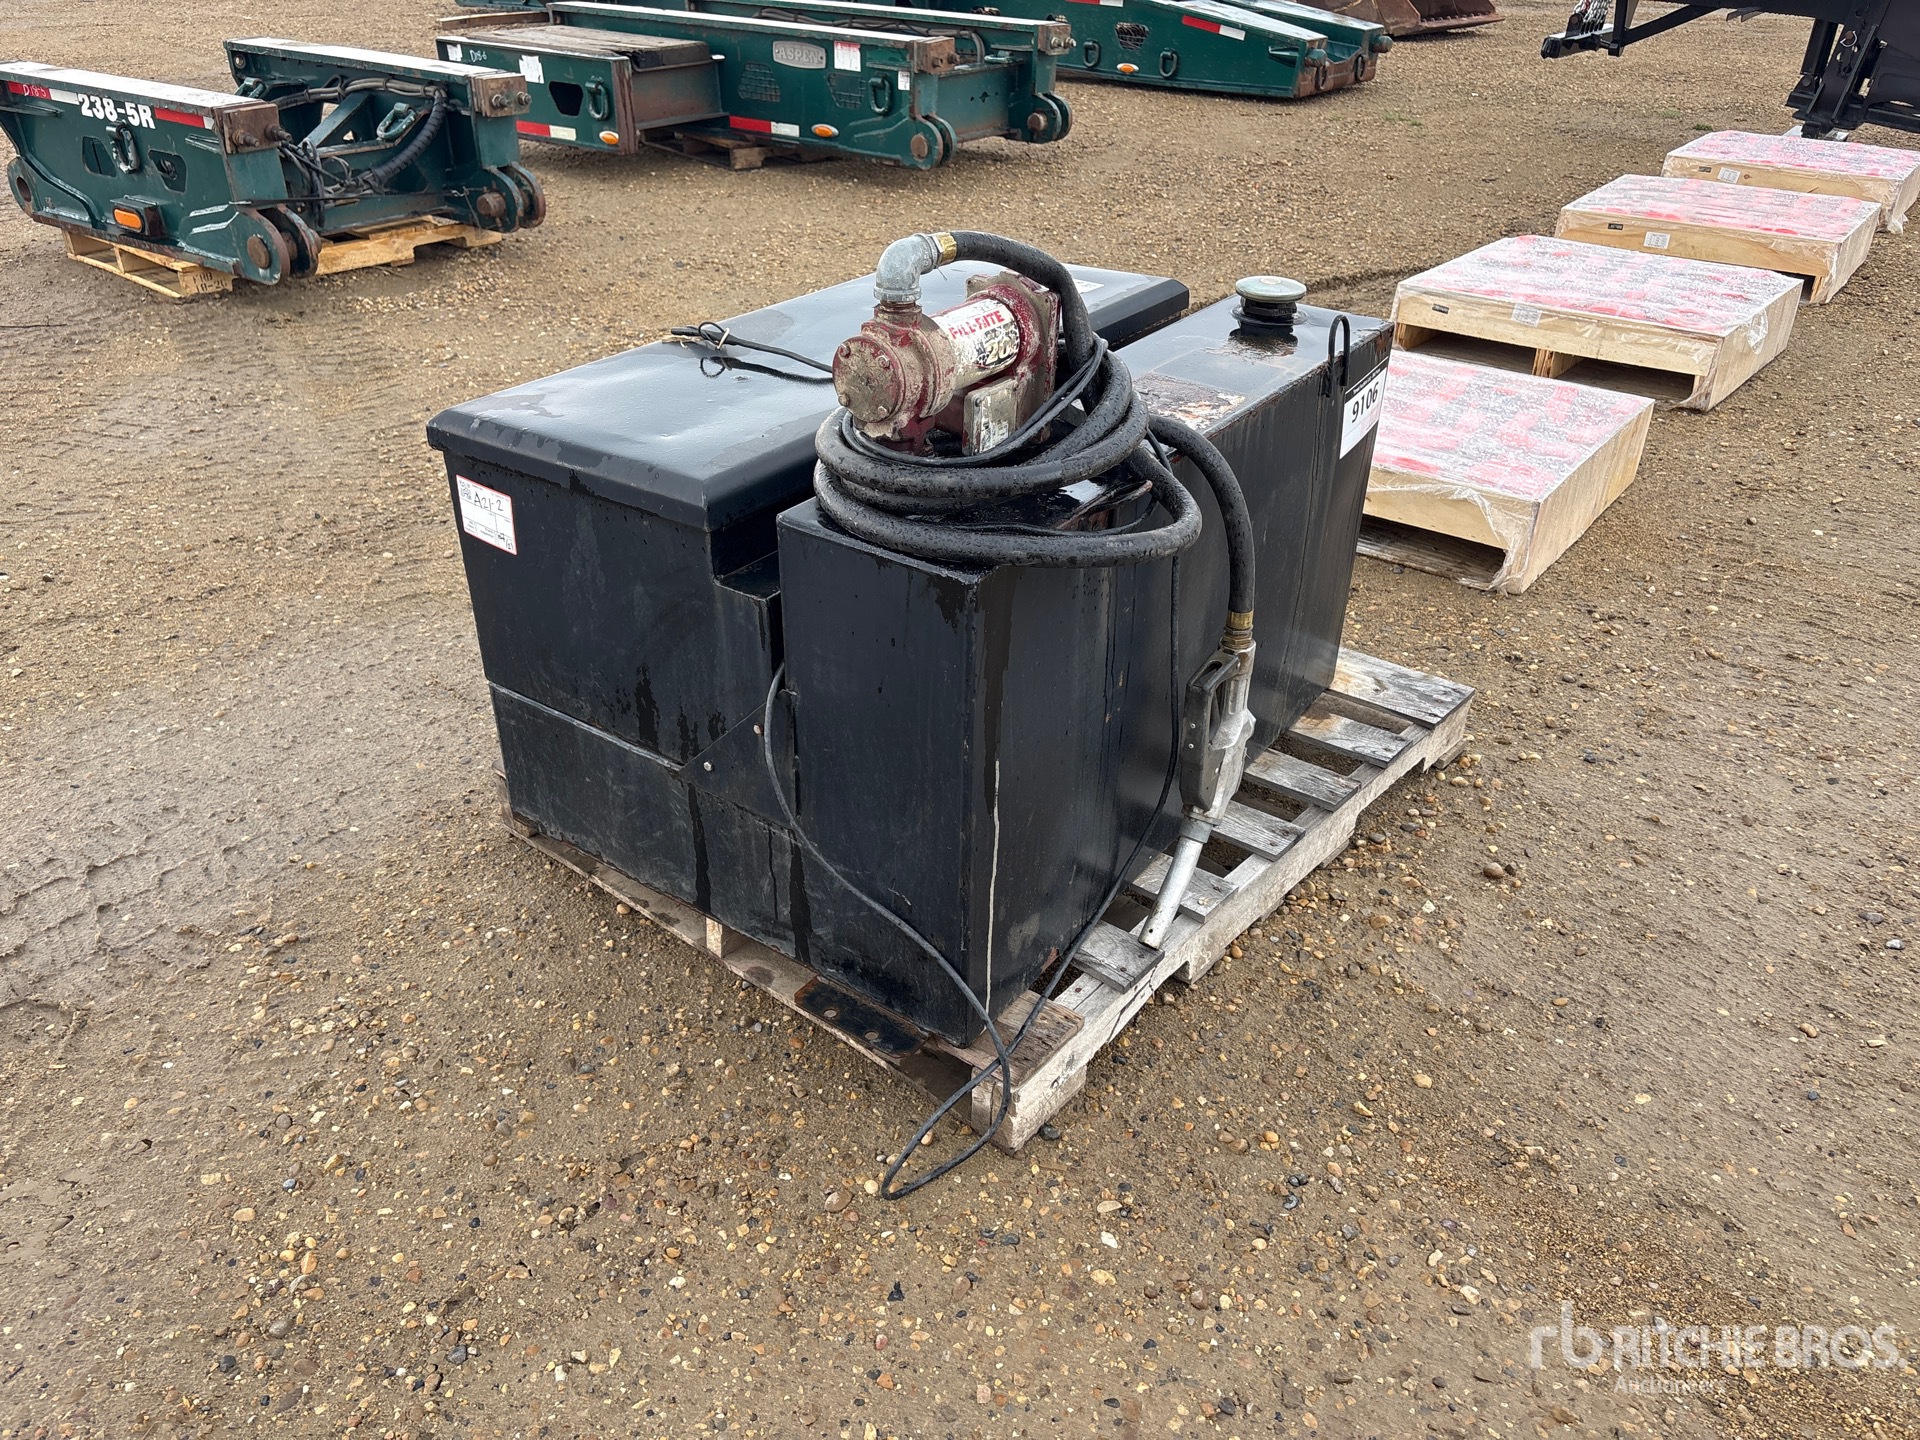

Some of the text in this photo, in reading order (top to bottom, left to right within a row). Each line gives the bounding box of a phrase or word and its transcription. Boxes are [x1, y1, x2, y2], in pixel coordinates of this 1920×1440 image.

[779, 46, 820, 64] ASPEN
[77, 94, 156, 129] 238-5R
[1352, 382, 1379, 423] 9106
[474, 491, 504, 512] A21-2
